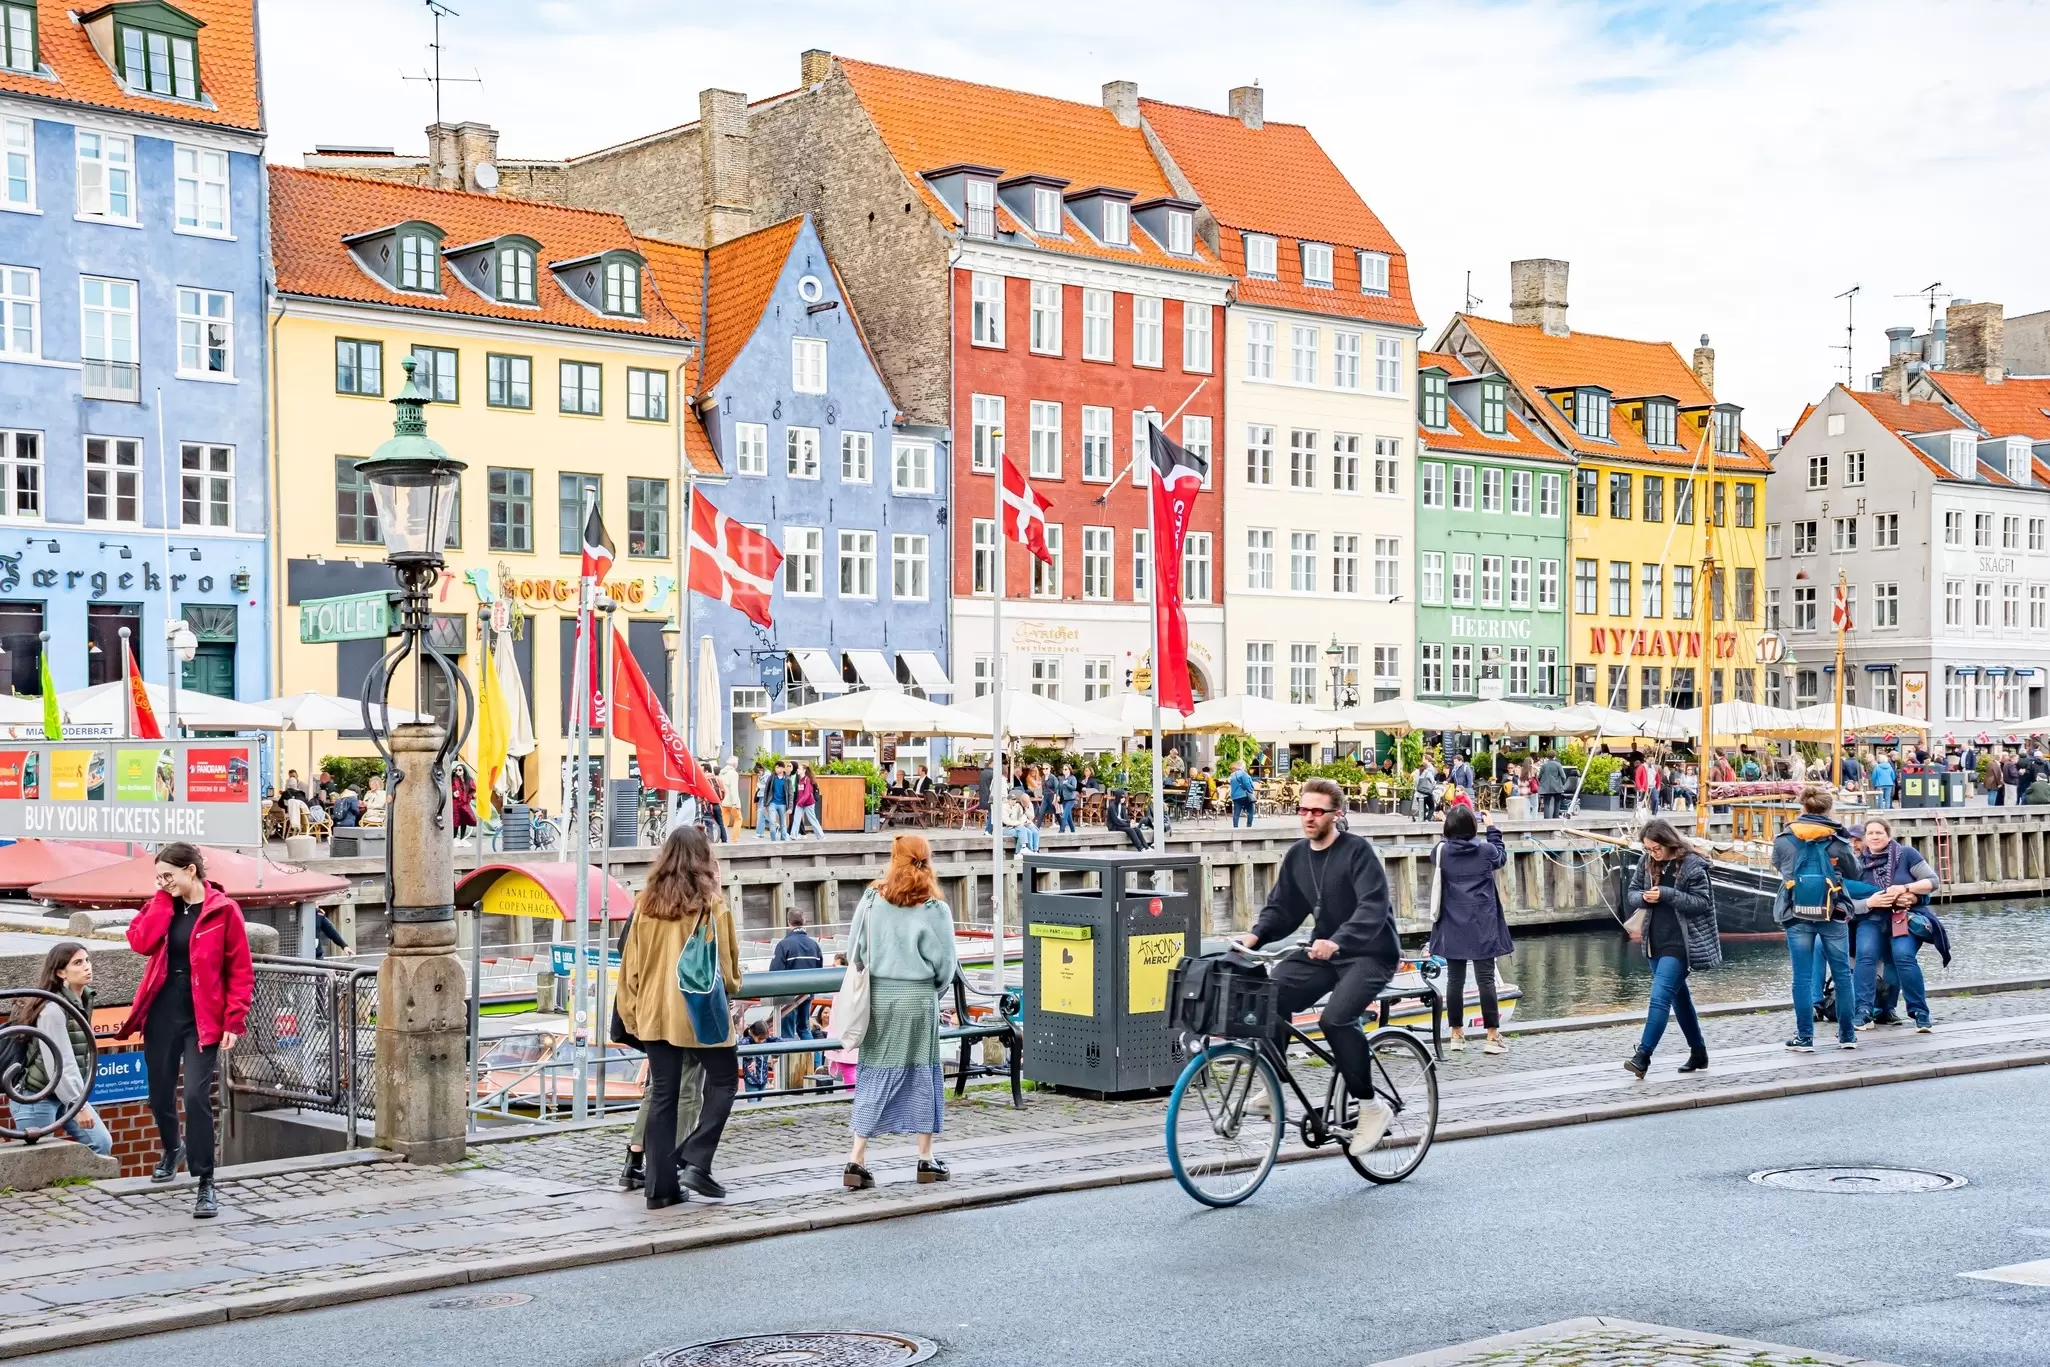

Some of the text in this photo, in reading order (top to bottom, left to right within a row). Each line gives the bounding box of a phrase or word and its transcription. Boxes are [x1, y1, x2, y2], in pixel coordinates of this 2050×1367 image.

[0, 551, 213, 599] Færgekro
[303, 599, 382, 636] TOILET
[1450, 615, 1532, 639] HEERING
[1590, 627, 1737, 658] NYHAVN 17
[1757, 637, 1779, 662] 17
[196, 764, 227, 774] PANORAMA
[25, 806, 205, 836] BUY YOUR TICKETS HERE
[500, 887, 527, 899] CANAL
[499, 900, 557, 915] COPENHAGEN
[1795, 905, 1823, 915] PUMA
[1143, 955, 1171, 965] MERCI
